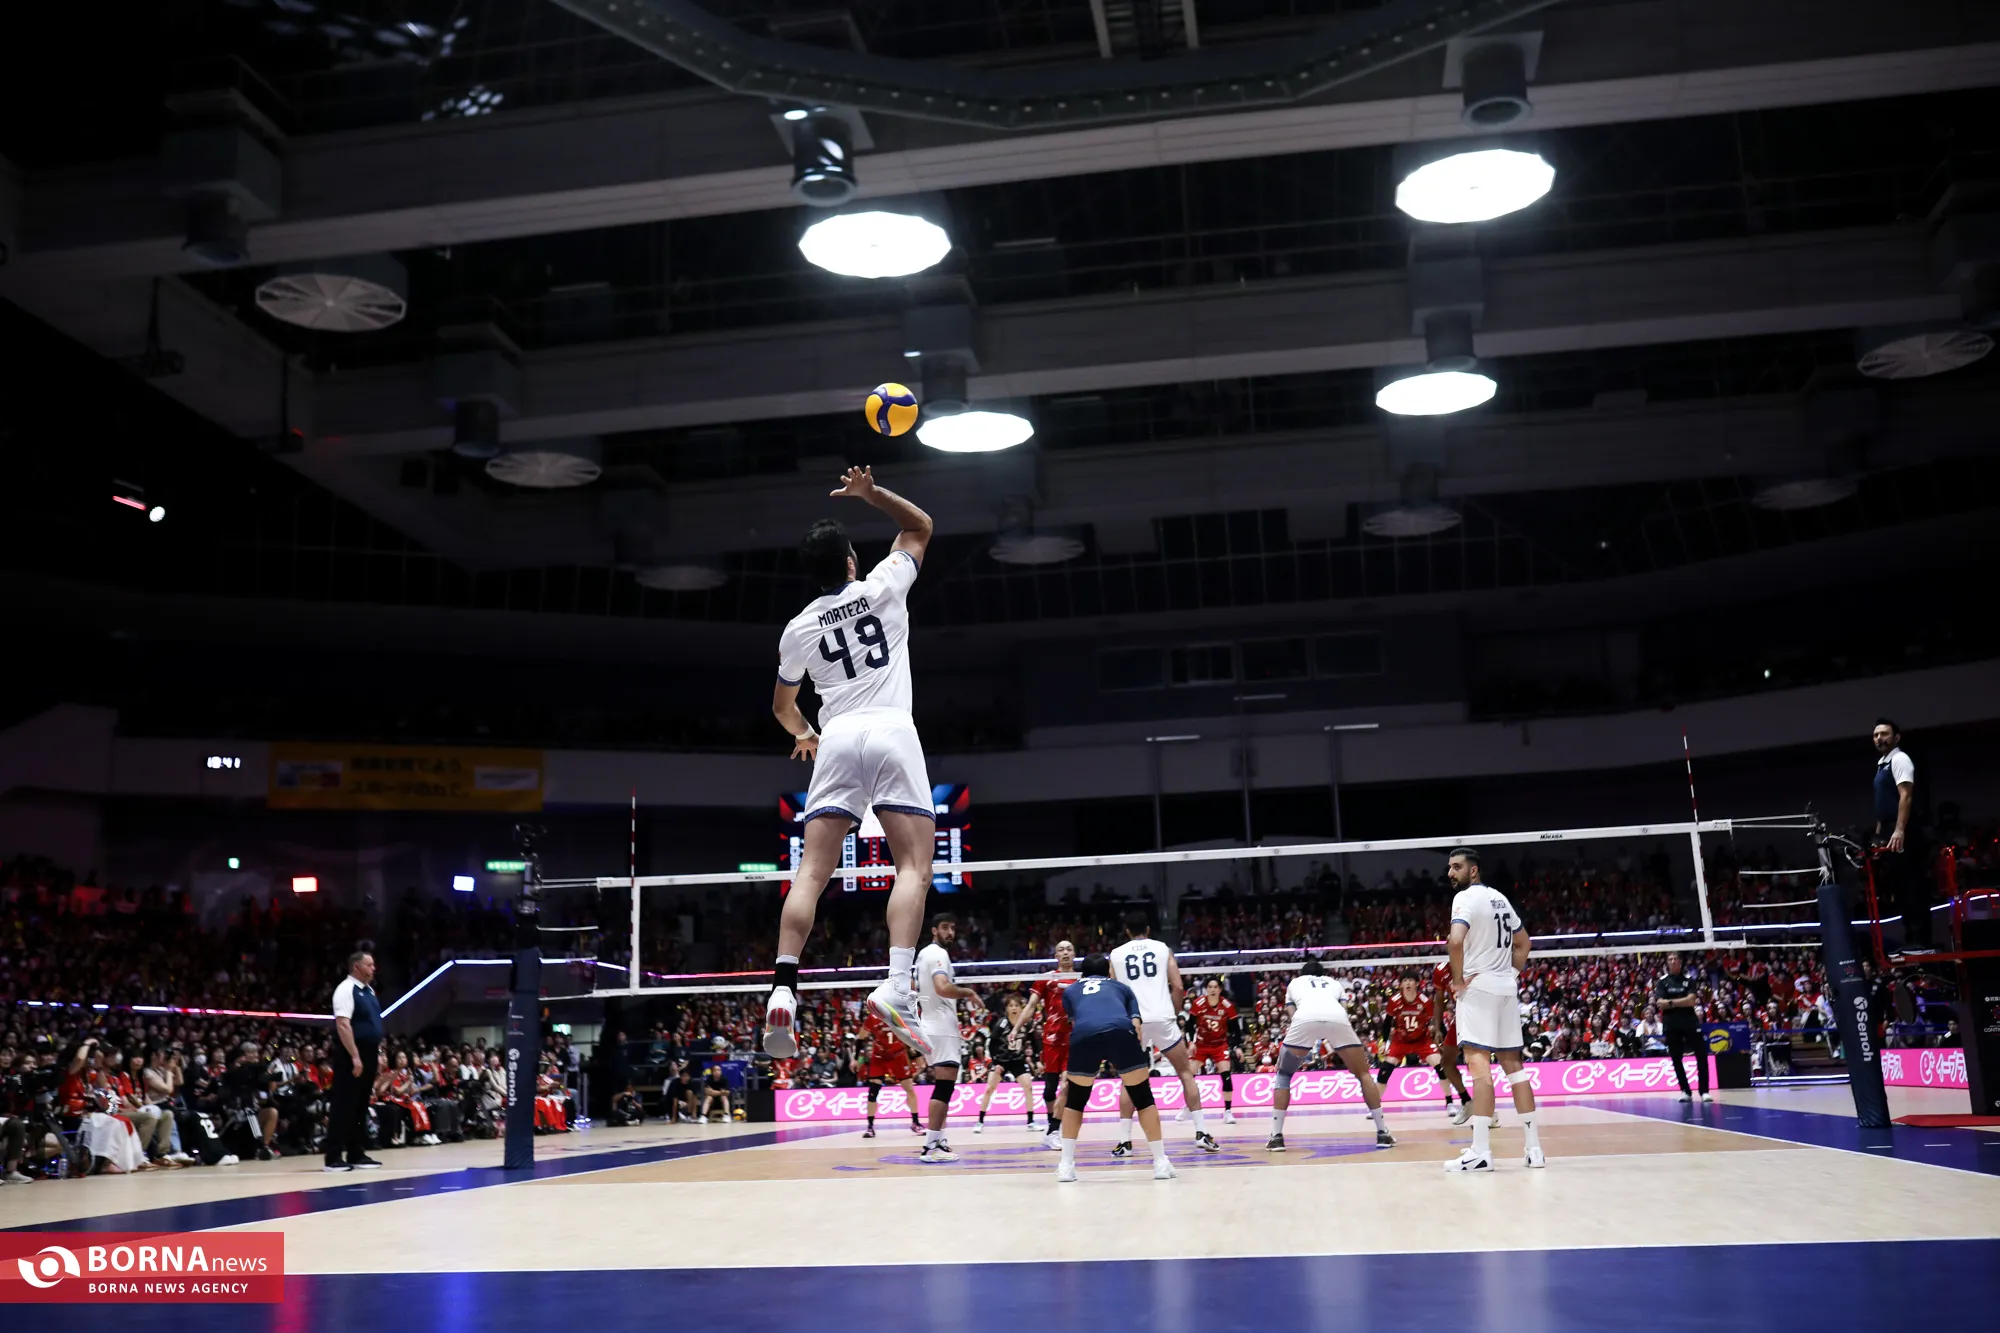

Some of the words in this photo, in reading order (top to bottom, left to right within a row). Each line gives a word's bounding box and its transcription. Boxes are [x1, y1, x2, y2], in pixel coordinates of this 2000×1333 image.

[818, 597, 871, 628] MORTEZA
[818, 614, 889, 680] 49
[1494, 913, 1511, 948] 15
[1125, 952, 1157, 980] 66
[1082, 980, 1101, 995] 8
[1404, 1016, 1418, 1032] 14
[1856, 1011, 1874, 1062] Senoh
[508, 1061, 518, 1107] Senoh
